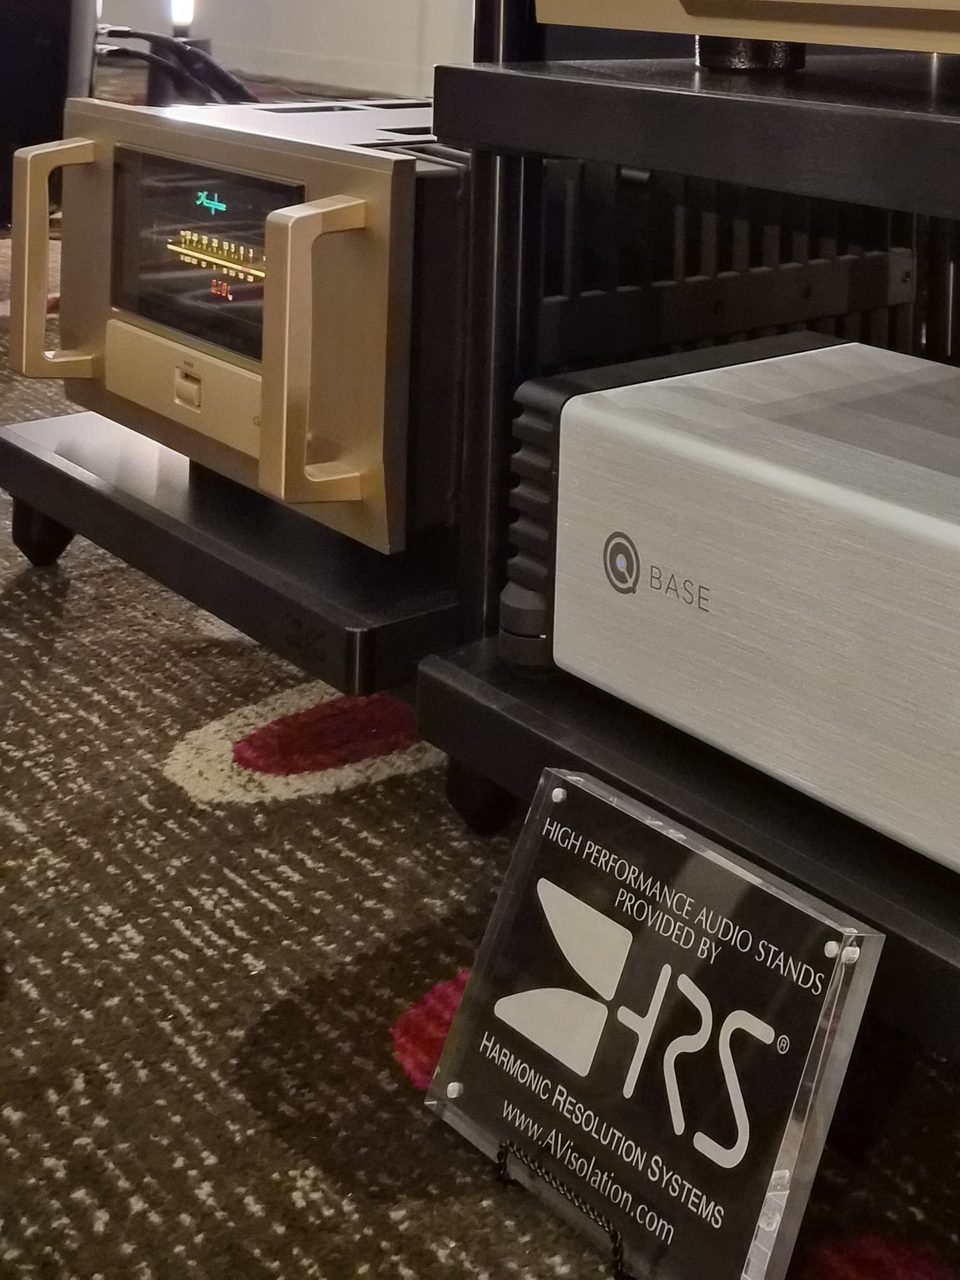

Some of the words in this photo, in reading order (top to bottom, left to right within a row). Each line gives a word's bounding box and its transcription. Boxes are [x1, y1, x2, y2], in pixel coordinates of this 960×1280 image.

[650, 564, 711, 613] BASE
[542, 817, 582, 854] HIGH
[582, 840, 695, 919] PERFORMANCE
[694, 906, 753, 952] AUDIO
[755, 940, 825, 995] STANDS
[614, 888, 696, 949] PROVIDED
[697, 936, 722, 965] BY
[479, 1031, 552, 1100] HARMONIC
[552, 1084, 647, 1171] RESOLUTION
[647, 1155, 725, 1229] SYSTEMS
[502, 1099, 675, 1245] www.AVisolation.com
